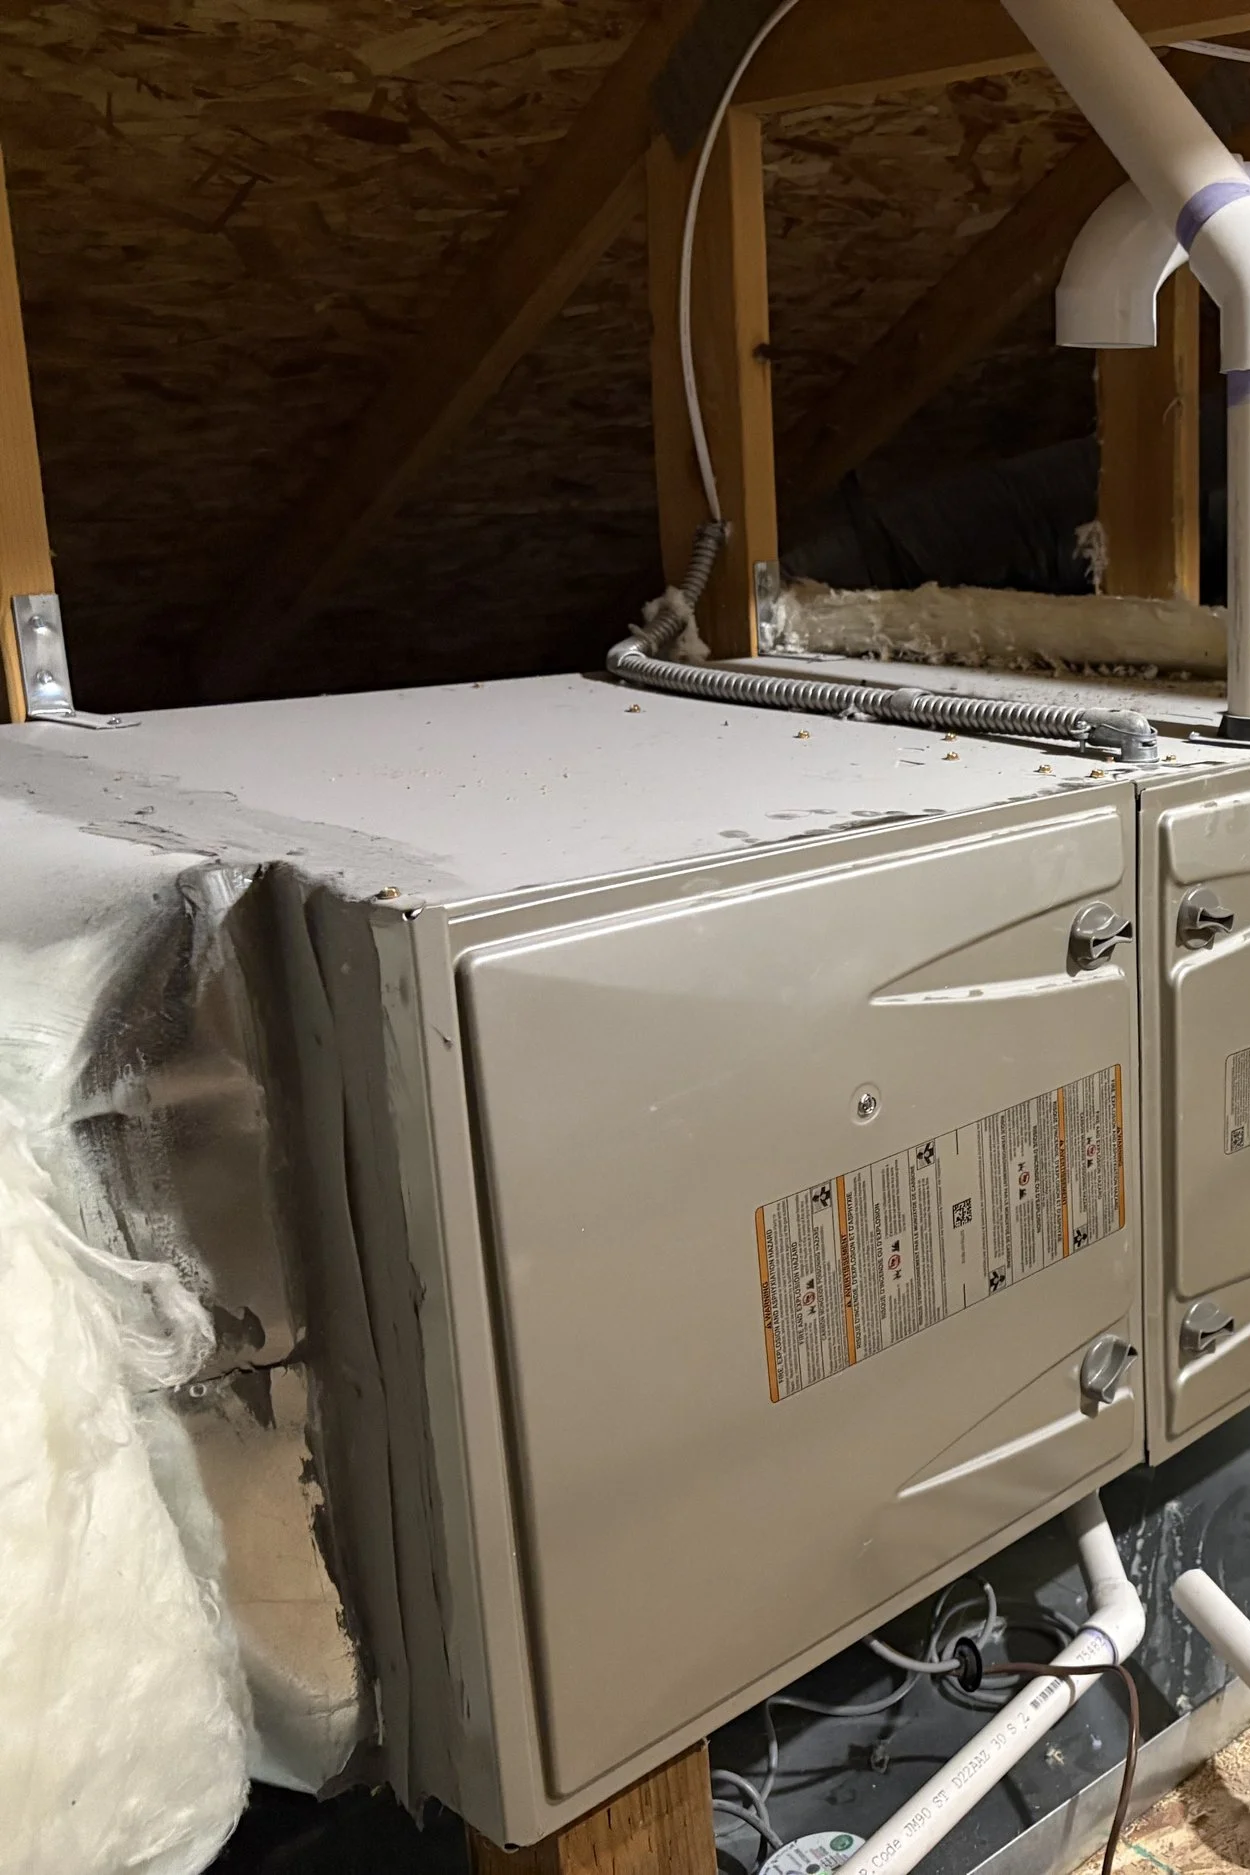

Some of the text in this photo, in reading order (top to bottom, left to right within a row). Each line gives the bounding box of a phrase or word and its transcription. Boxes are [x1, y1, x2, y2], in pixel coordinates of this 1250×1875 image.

[791, 1241, 799, 1272] HAZARD
[841, 1233, 852, 1299] AVERTISSEMENT
[762, 1281, 772, 1322] WARNING
[794, 1272, 802, 1312] EXPLOSION
[903, 1807, 932, 1838] JM90
[932, 1789, 950, 1809] ST
[1006, 1723, 1018, 1736] S
